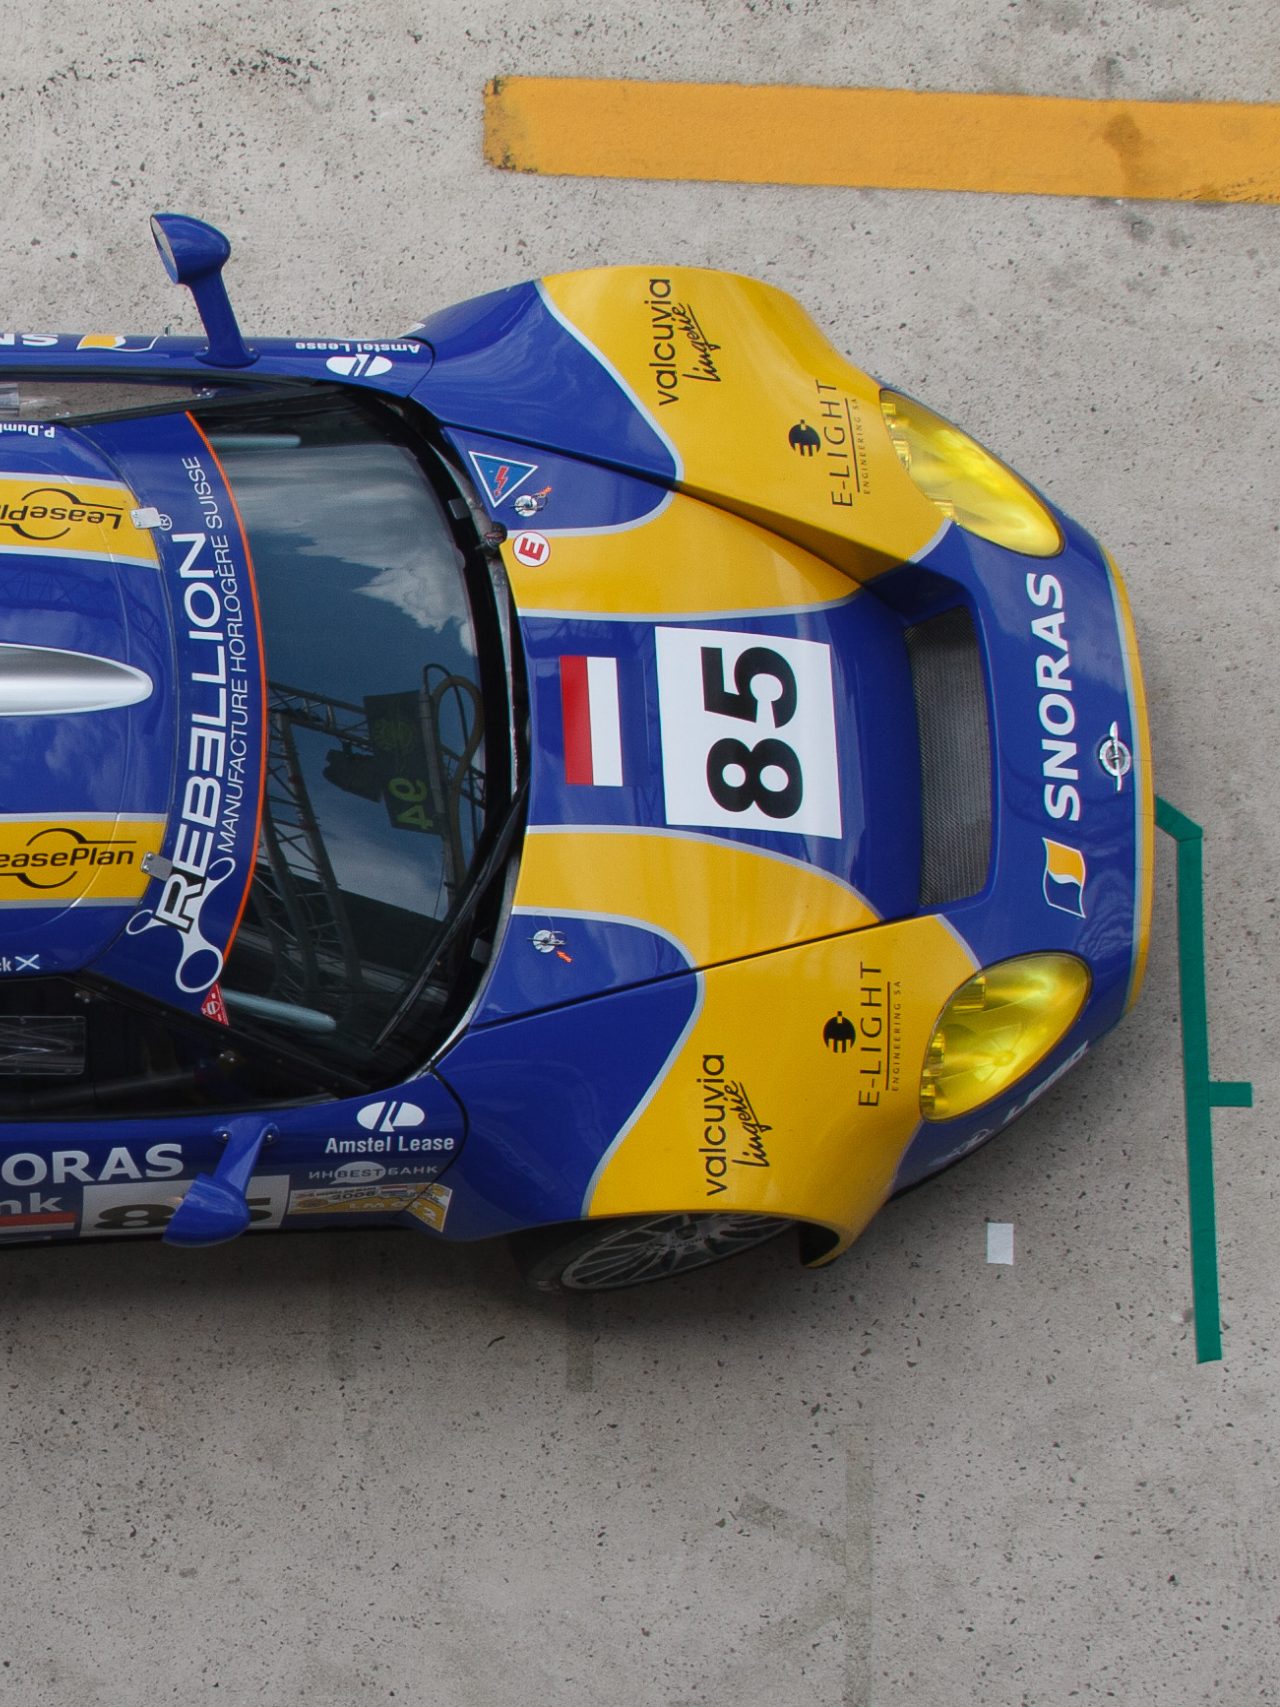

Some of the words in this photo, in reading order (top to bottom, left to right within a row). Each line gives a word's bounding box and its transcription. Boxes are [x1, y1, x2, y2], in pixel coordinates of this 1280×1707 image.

[295, 341, 351, 353] Lease
[357, 342, 421, 354] Amstel
[644, 278, 680, 407] valcuvia
[181, 456, 223, 530] SUISSE
[815, 379, 854, 507] E-LIGHT
[851, 416, 870, 495] ENGINEERING
[210, 534, 248, 673] HORLOGÈRE
[700, 646, 804, 820] 85
[1025, 573, 1081, 822] SNORAS
[216, 678, 250, 853] MANUFACTURE
[857, 961, 883, 1107] E-LIGHT
[891, 1003, 903, 1092] ENGINEERING
[892, 980, 902, 997] SA
[324, 1136, 391, 1154] Amstel
[398, 1136, 455, 1152] Lease
[696, 1054, 728, 1197] valcuvia
